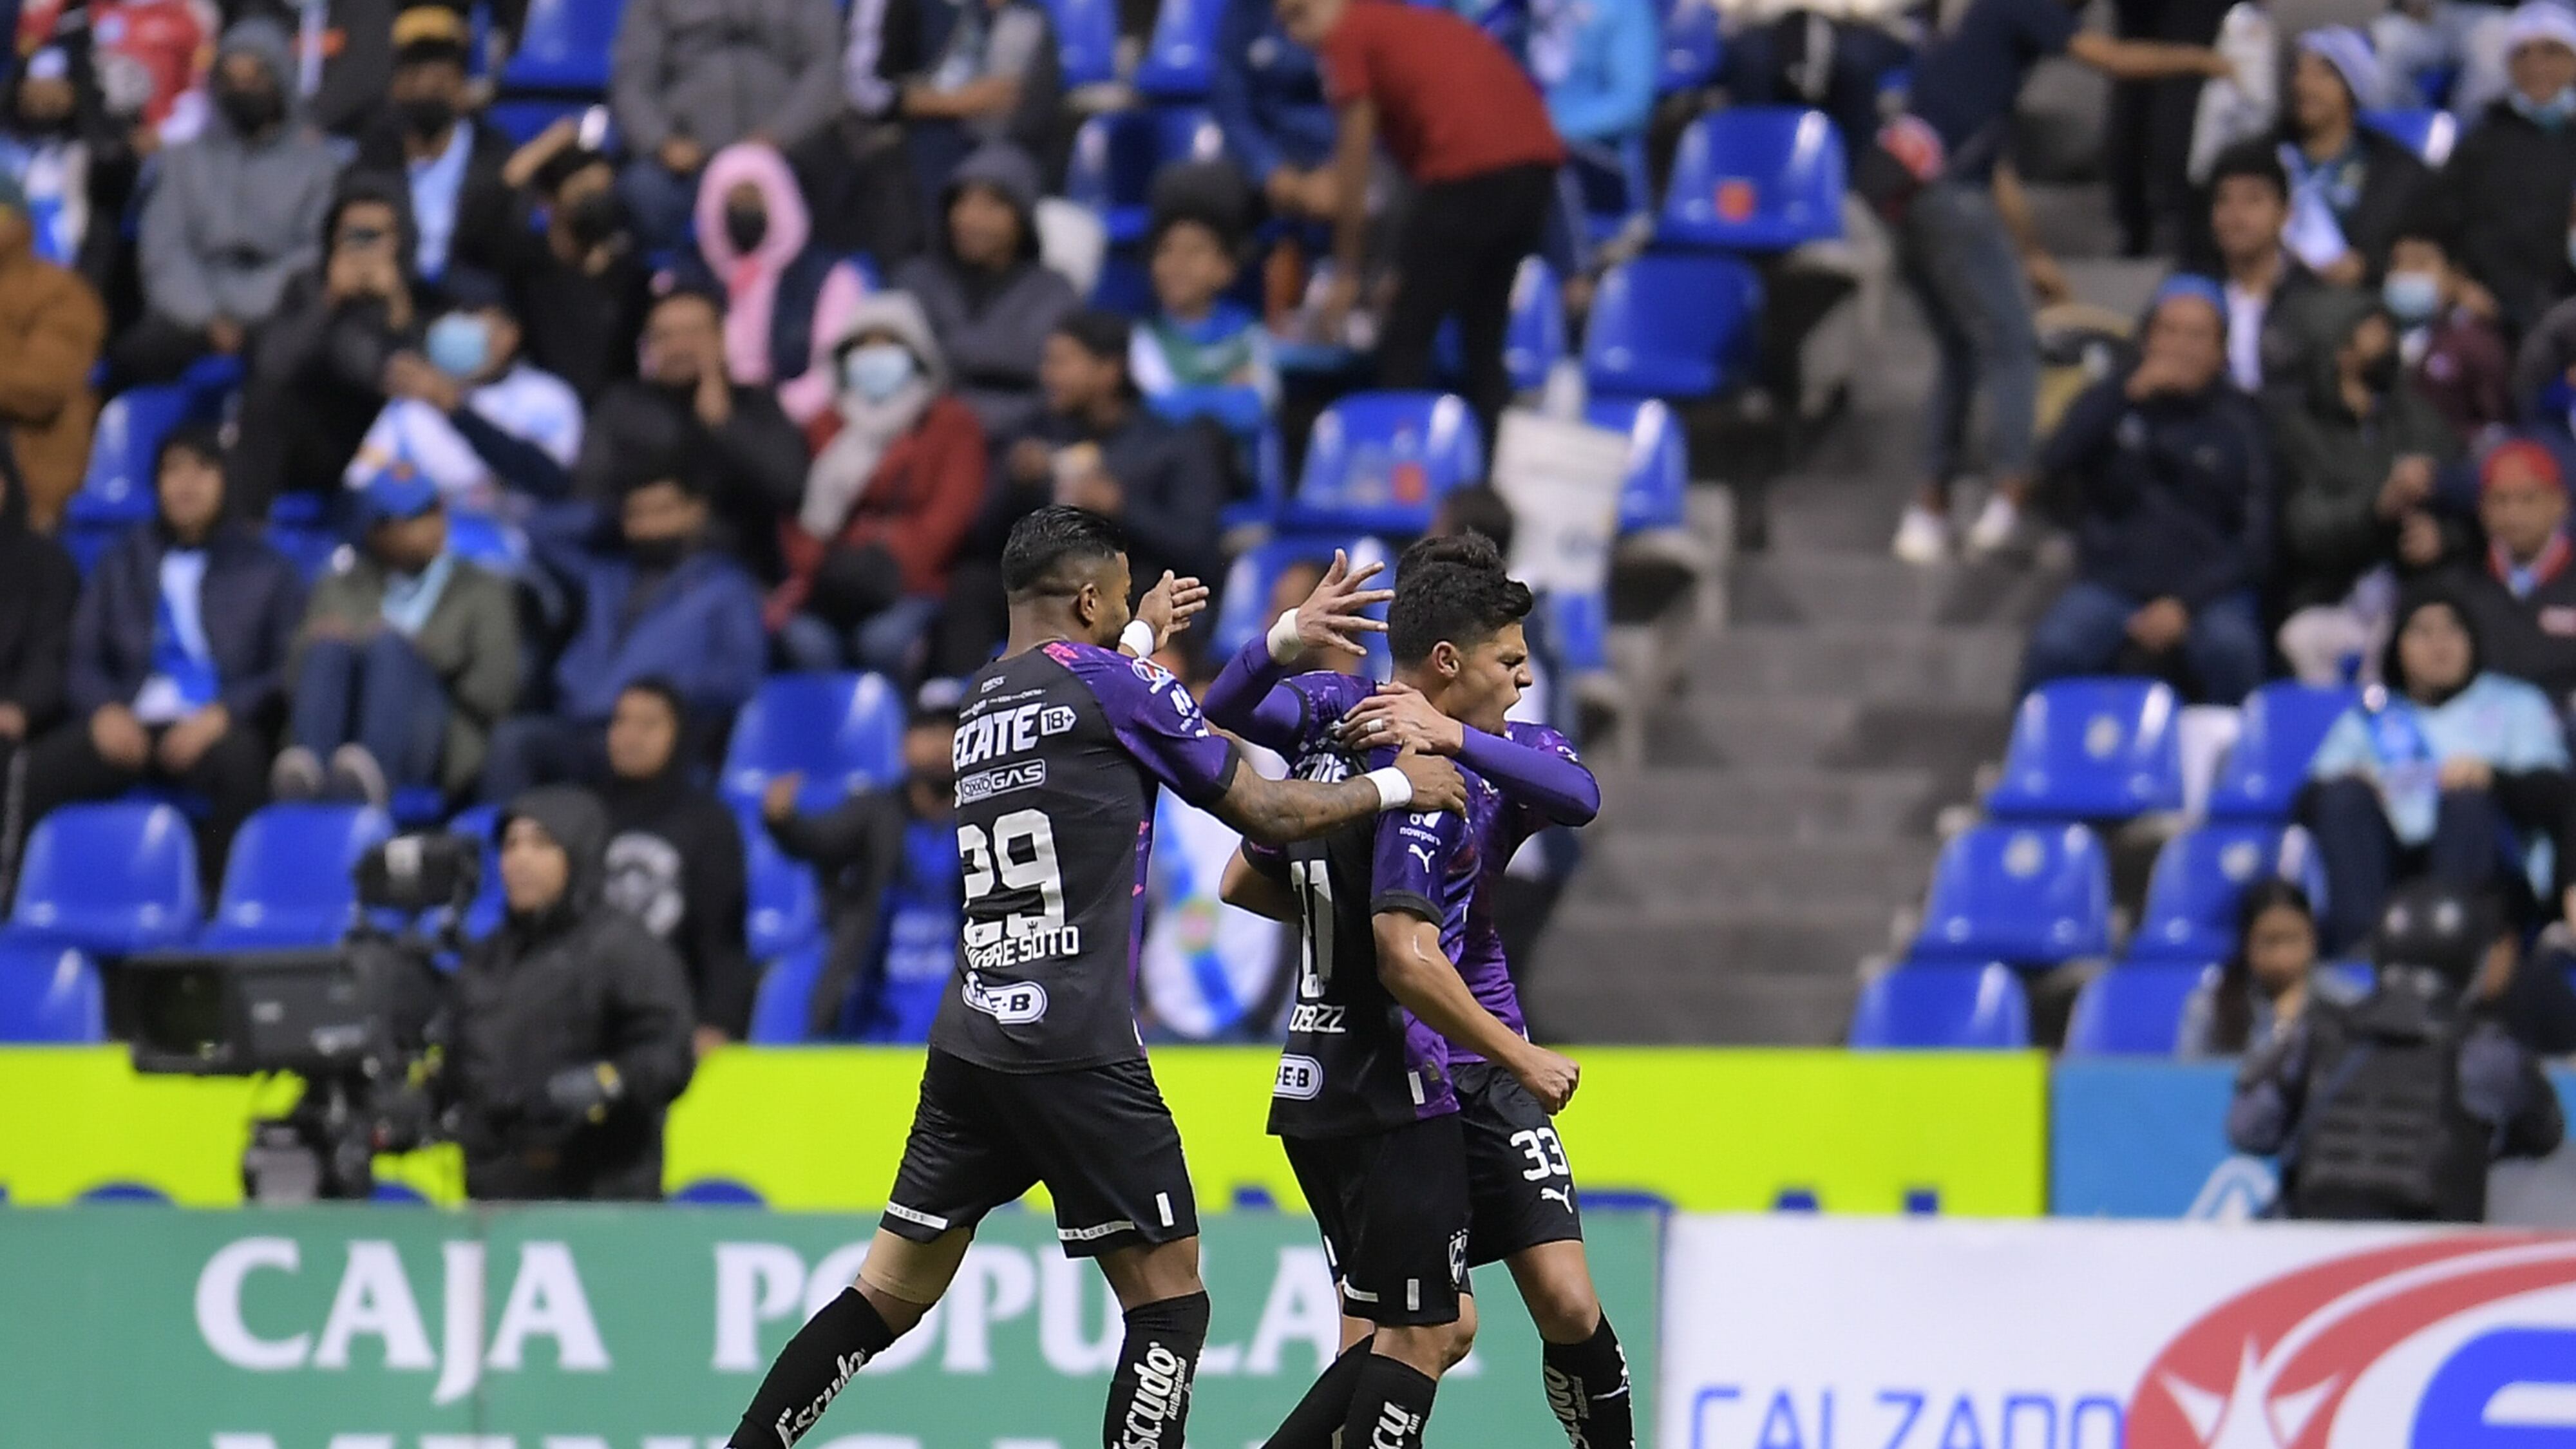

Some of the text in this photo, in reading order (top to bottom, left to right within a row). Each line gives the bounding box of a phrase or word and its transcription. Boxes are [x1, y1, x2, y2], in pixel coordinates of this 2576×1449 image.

[1043, 710, 1074, 732] 18+
[991, 764, 1043, 790] GAS
[1510, 1127, 1569, 1181] 33
[194, 1236, 612, 1406] CAJA
[1113, 1347, 1177, 1449] scudo
